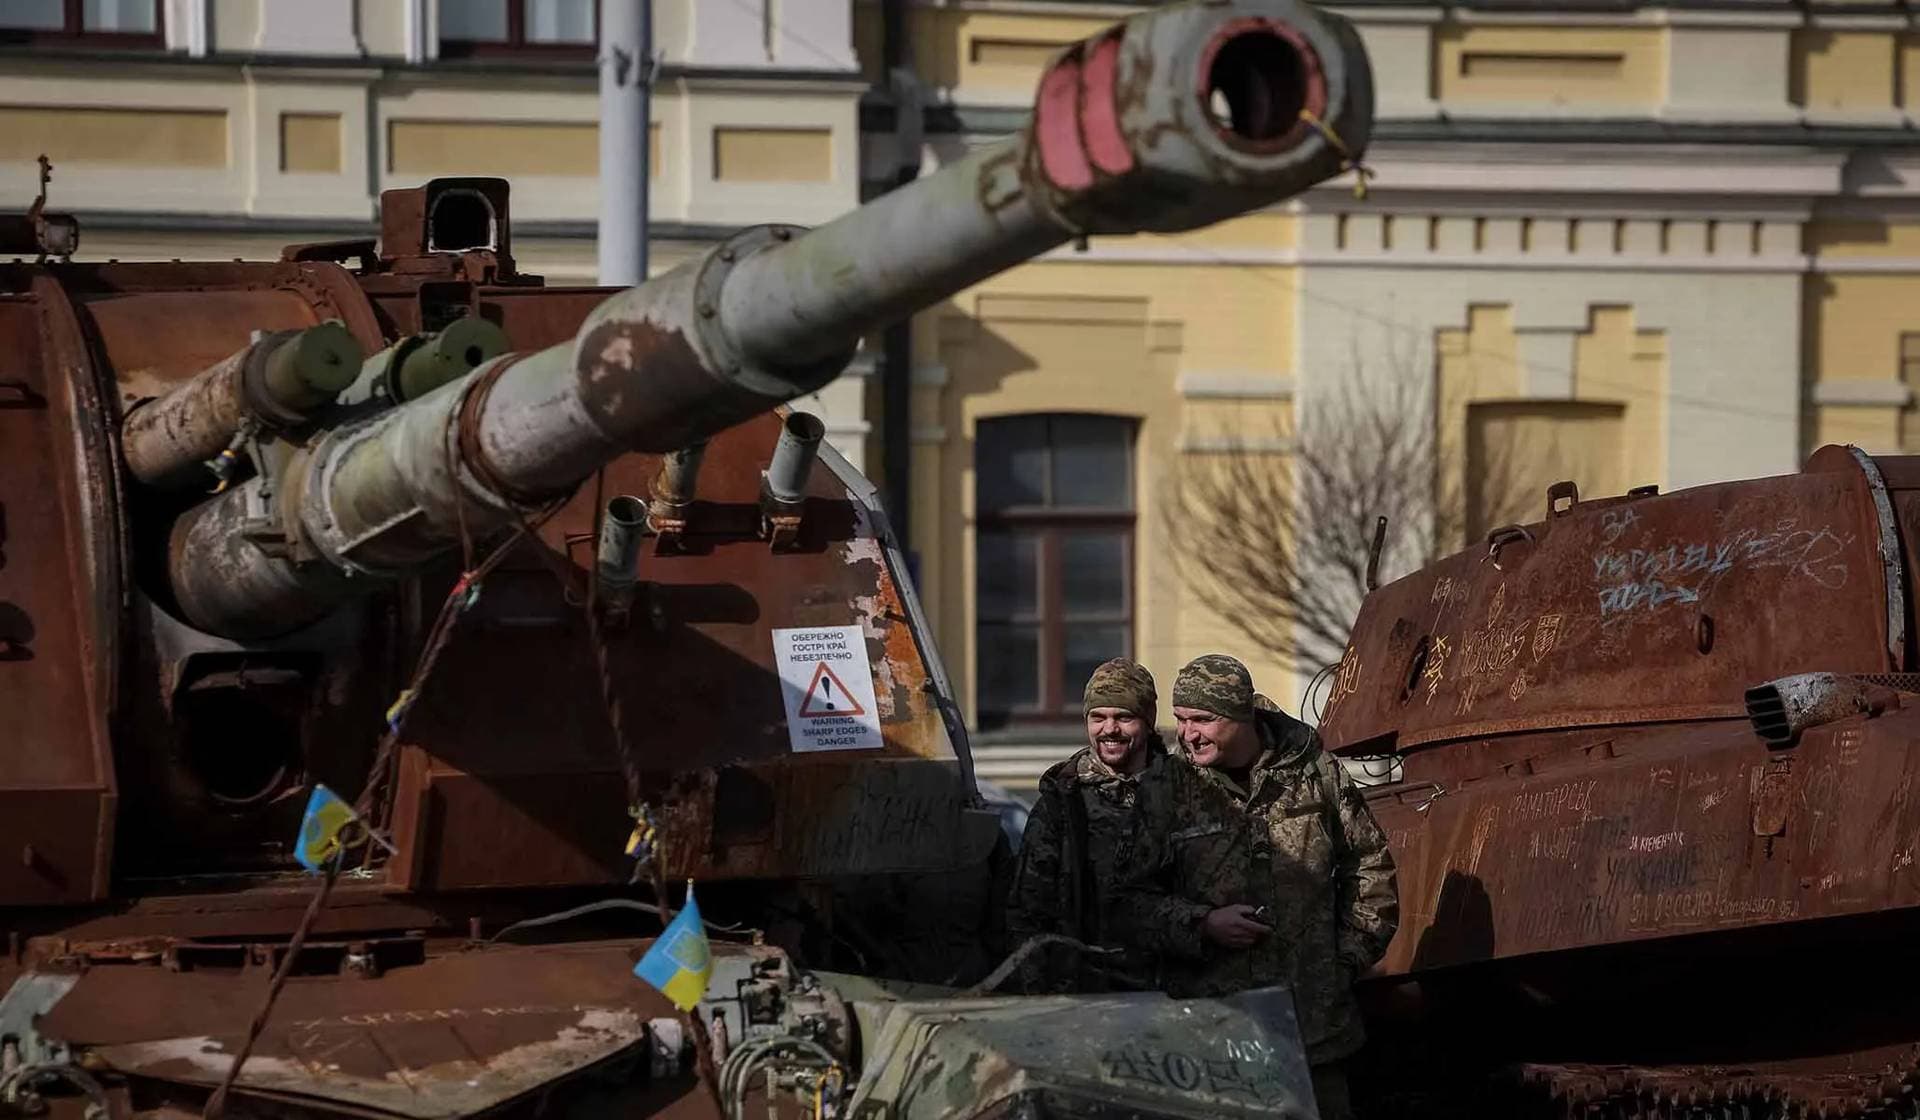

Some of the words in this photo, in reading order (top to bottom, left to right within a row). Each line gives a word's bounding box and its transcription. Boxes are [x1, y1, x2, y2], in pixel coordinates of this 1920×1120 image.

[791, 632, 844, 642] ОБЕРЕЖНО
[792, 643, 825, 652] ГОСТРІ
[826, 641, 847, 651] КРАЇ
[790, 652, 852, 662] НЕБЕЗПЕЧНО
[811, 717, 855, 726] WARNING
[803, 727, 834, 737] SHARP
[836, 726, 867, 735] EDGES
[817, 737, 856, 746] DANGER
